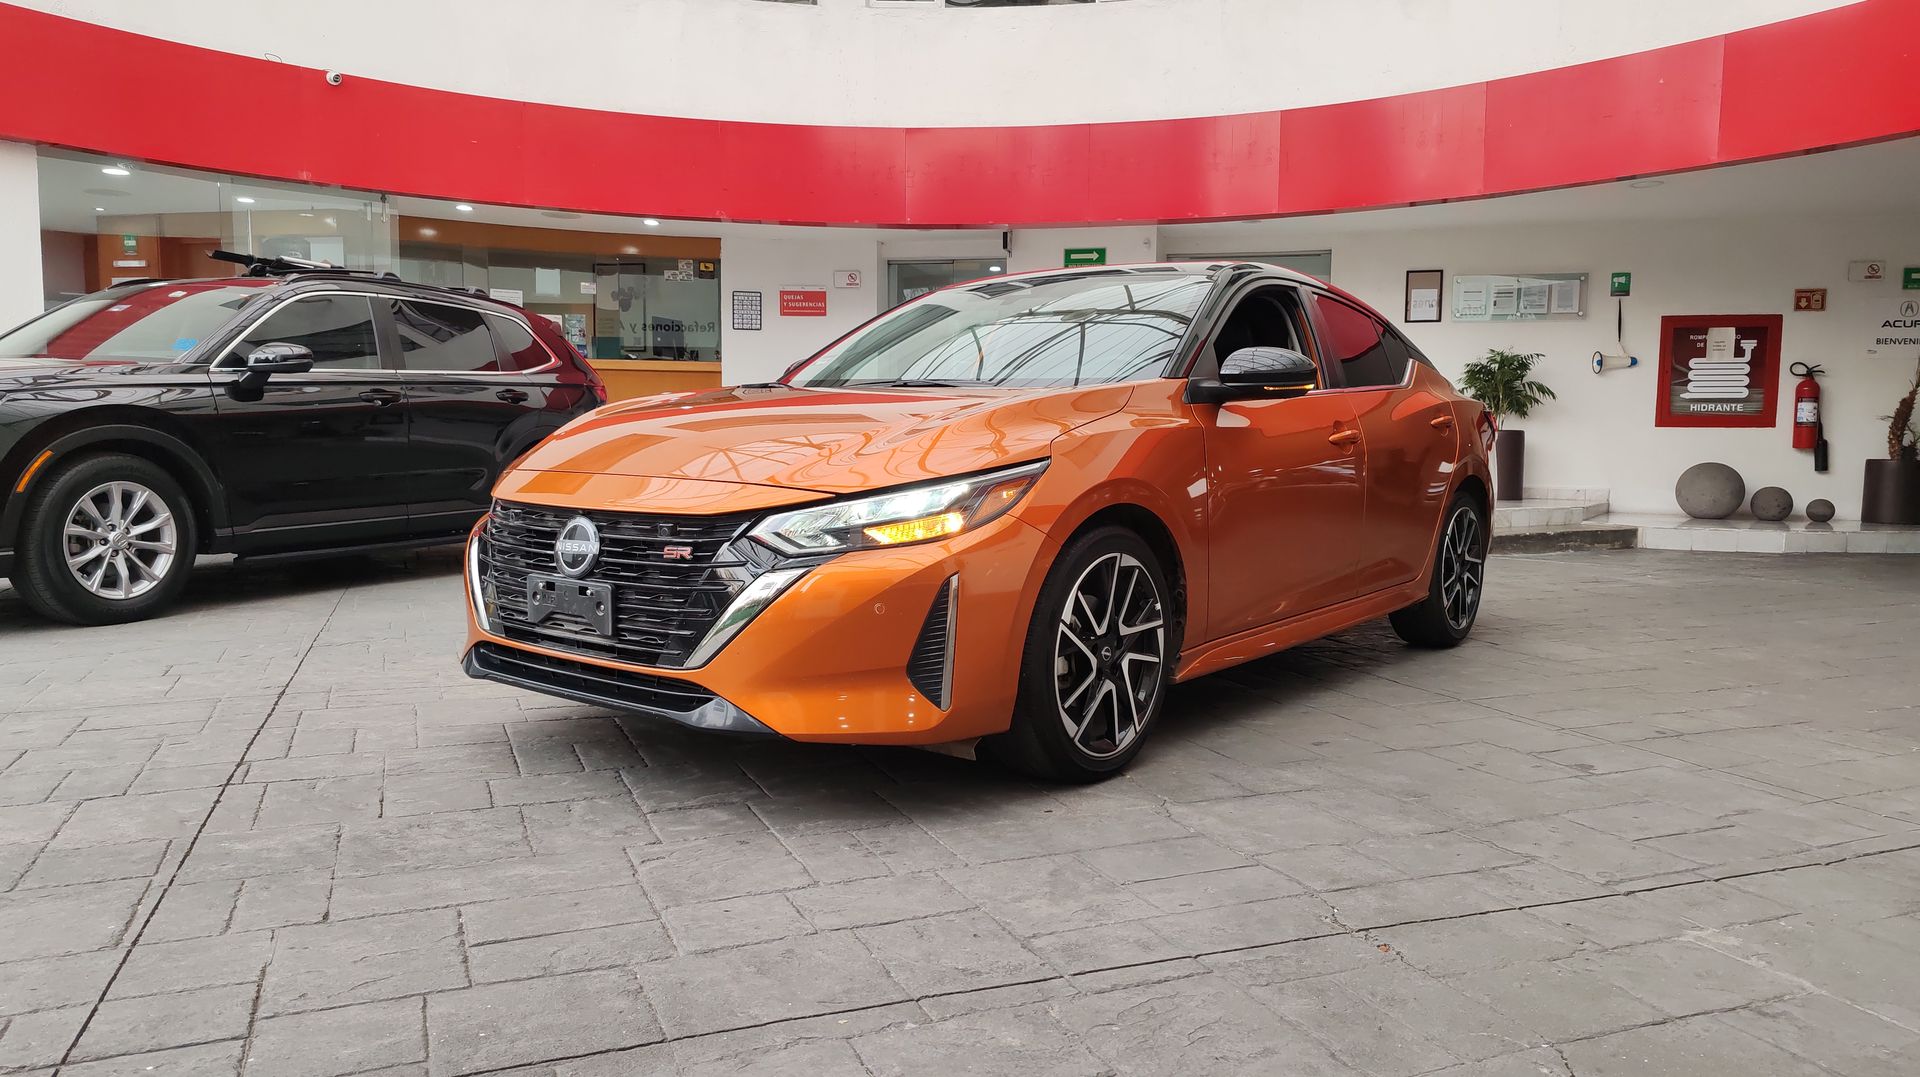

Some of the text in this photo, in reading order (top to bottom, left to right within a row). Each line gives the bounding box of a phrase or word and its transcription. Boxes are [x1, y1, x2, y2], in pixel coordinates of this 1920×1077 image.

[1875, 337, 1920, 345] BIENVENI
[1690, 403, 1744, 412] HIDRANTE
[556, 541, 598, 553] NISSAN
[663, 545, 694, 560] SR
